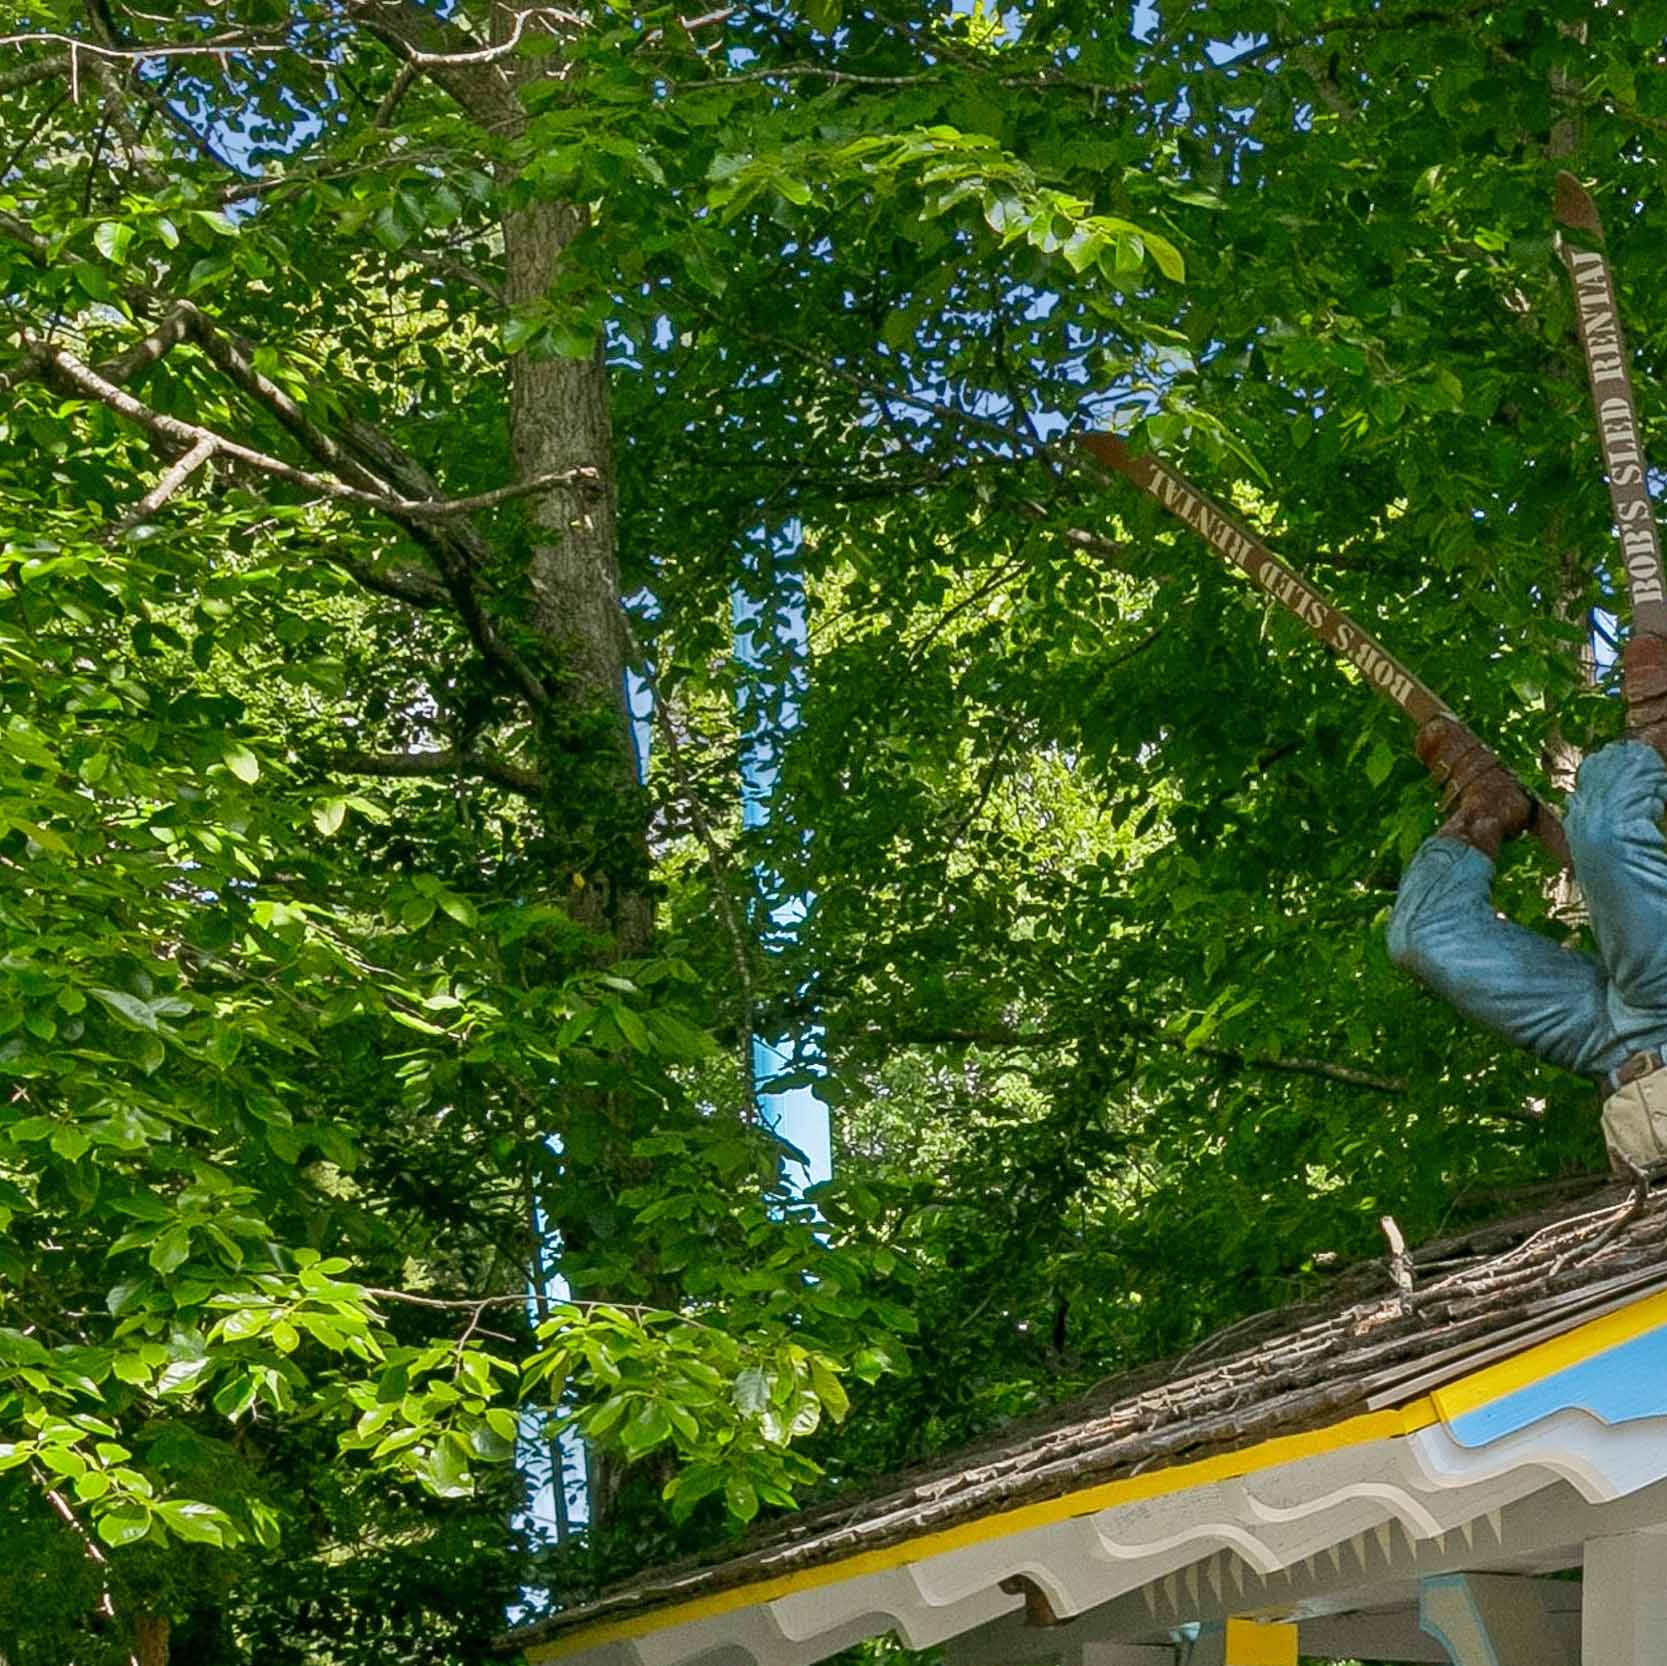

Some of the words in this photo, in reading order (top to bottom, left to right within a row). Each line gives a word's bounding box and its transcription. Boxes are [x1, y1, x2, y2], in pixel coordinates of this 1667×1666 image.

[1571, 252, 1624, 384] RENTAL
[1600, 397, 1643, 486] SLED
[1146, 464, 1254, 567] RENTAL
[1618, 500, 1663, 605] BOB'S
[1259, 561, 1328, 628] SLED
[1332, 624, 1414, 707] BOB'S
